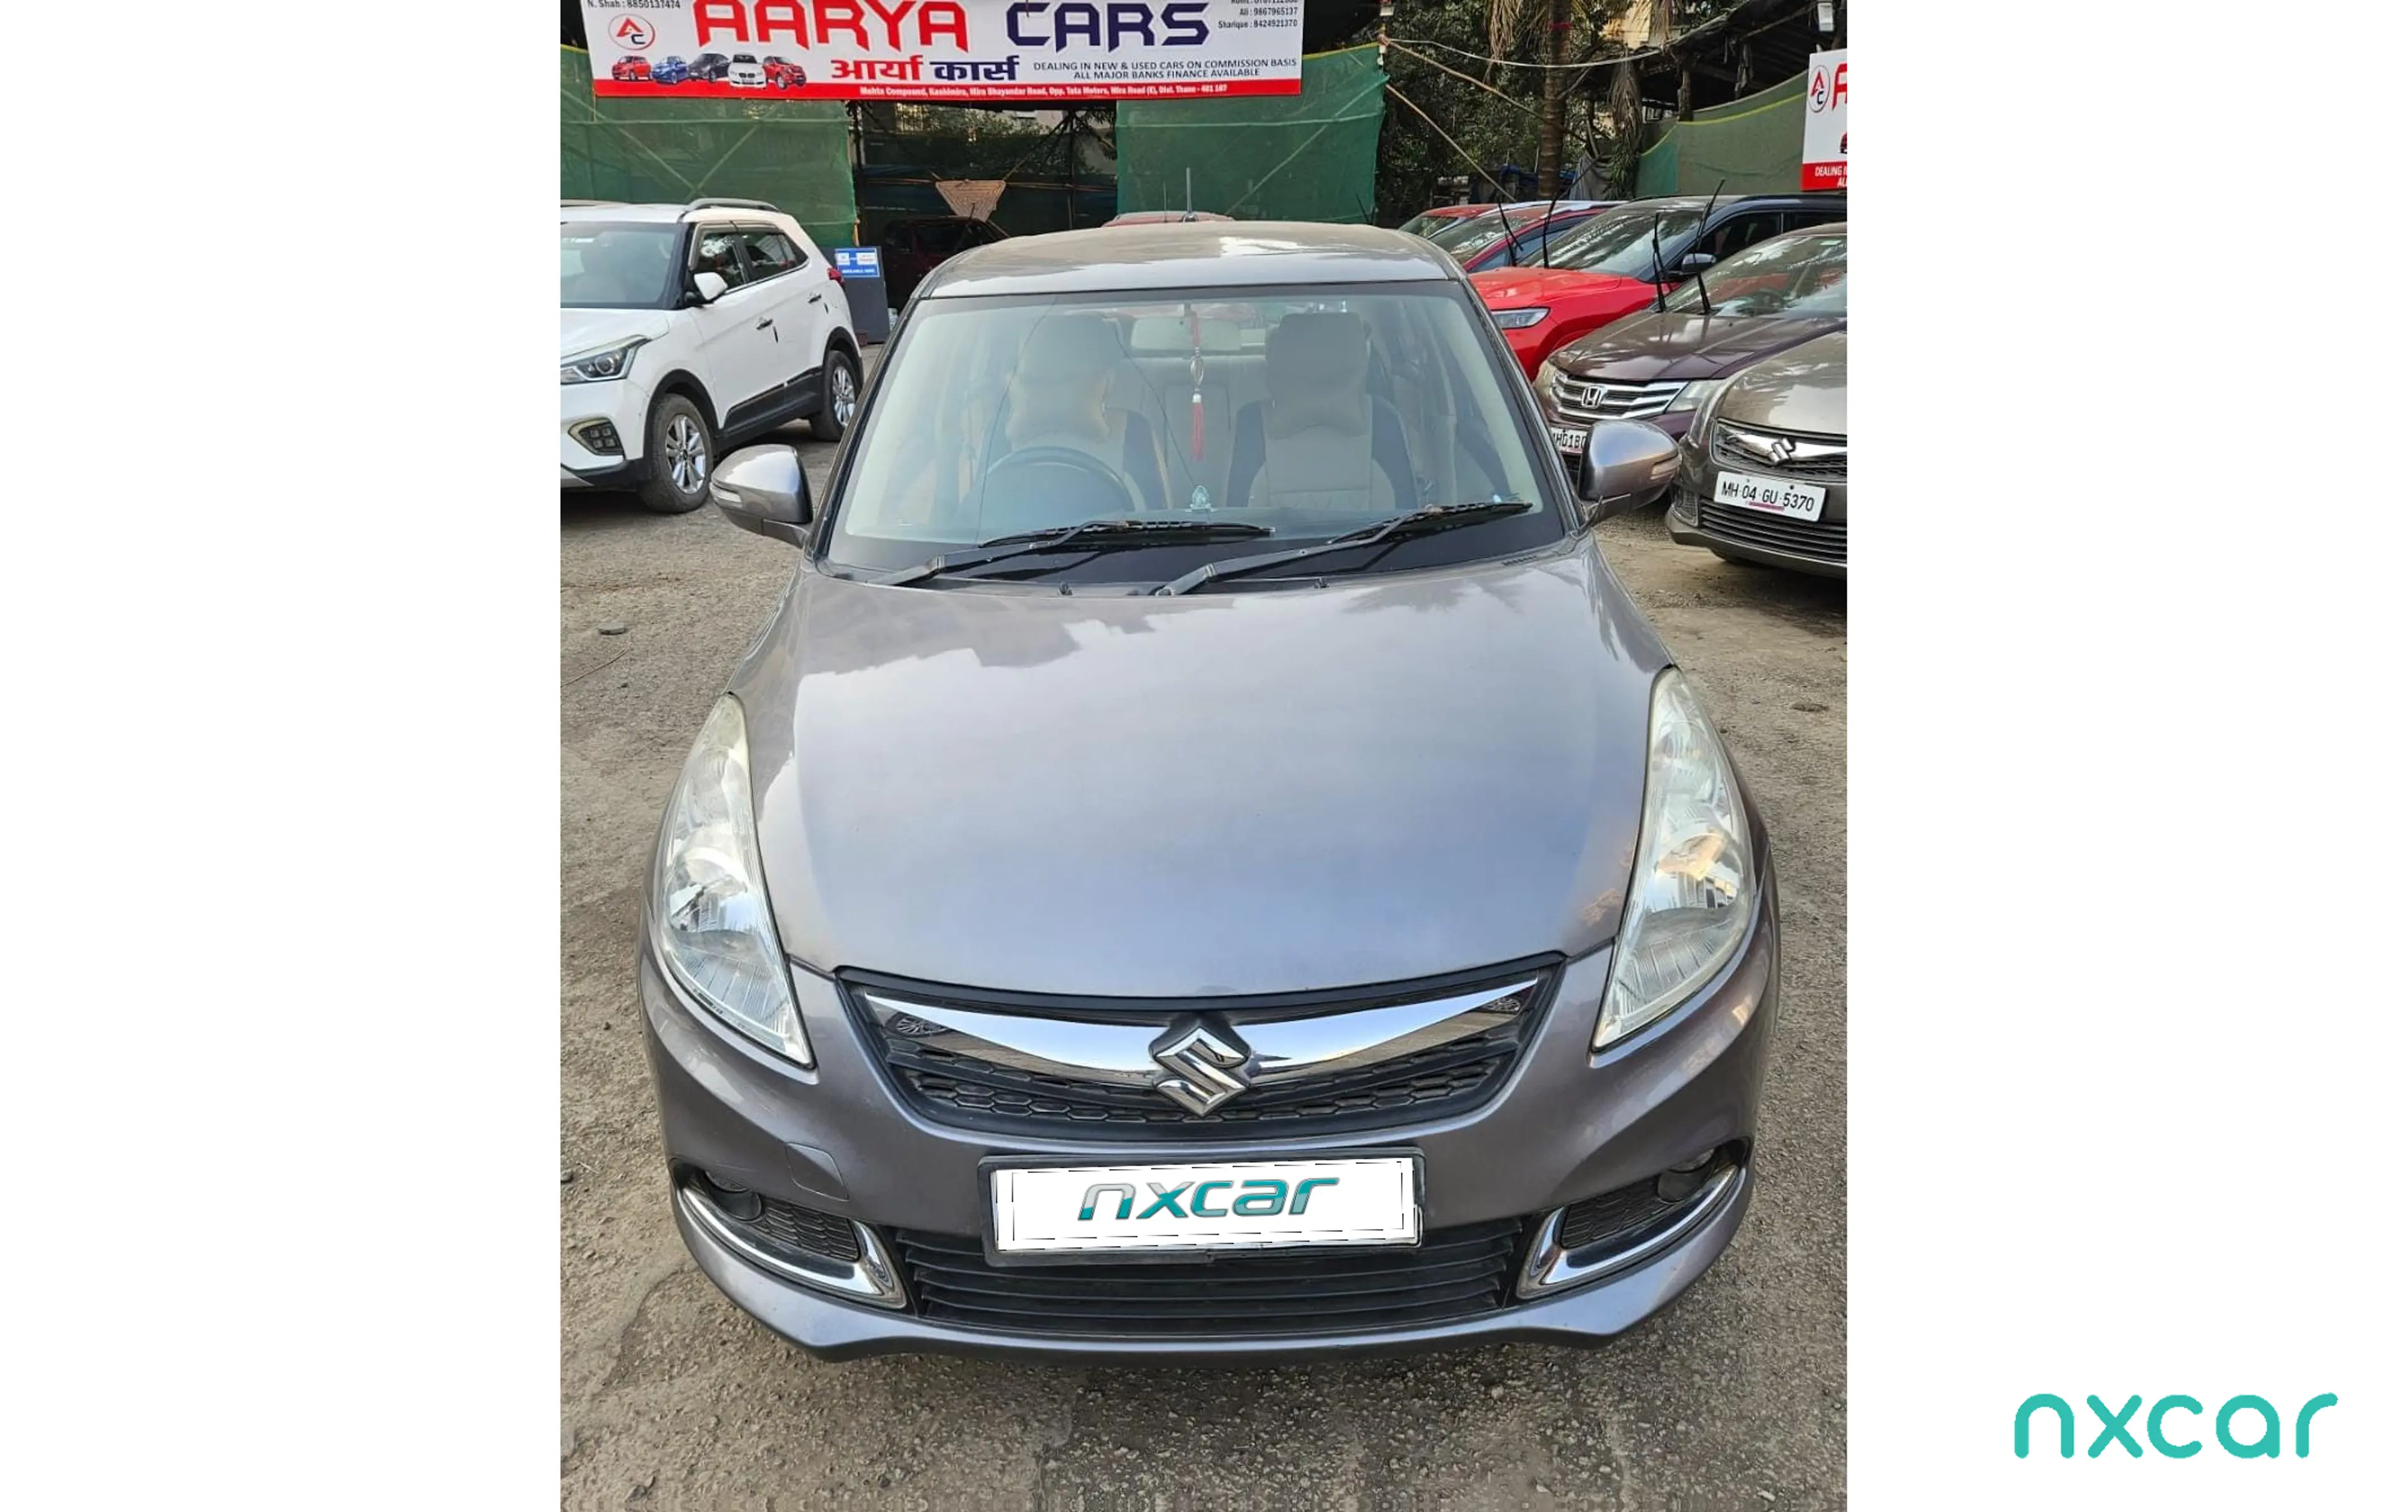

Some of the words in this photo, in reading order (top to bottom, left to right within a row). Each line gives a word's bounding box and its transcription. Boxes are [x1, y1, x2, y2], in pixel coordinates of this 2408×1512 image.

[692, 0, 969, 53] AARYA
[1006, 1, 1211, 53] CARS
[831, 55, 924, 81] आर्या
[930, 55, 1020, 81] कार्स
[1033, 62, 1078, 71] DEALING
[1094, 62, 1118, 70] NEW
[1121, 62, 1129, 70] &
[1131, 61, 1157, 70] USED
[1160, 61, 1185, 70] CARS
[1187, 61, 1202, 69] ON
[1205, 59, 1269, 68] COMMISSION
[1271, 58, 1297, 67] BASIS
[1074, 71, 1091, 80] ALL
[1094, 71, 1129, 79] MAJOR
[1131, 70, 1164, 79] BANKS
[1167, 70, 1210, 78] FINANCE
[1210, 68, 1260, 78] AVAILABLE
[1814, 166, 1842, 177] DEALING
[1721, 481, 1739, 497] MH
[1741, 485, 1757, 500] 04
[1762, 489, 1778, 504] GU
[1783, 493, 1815, 512] 5370
